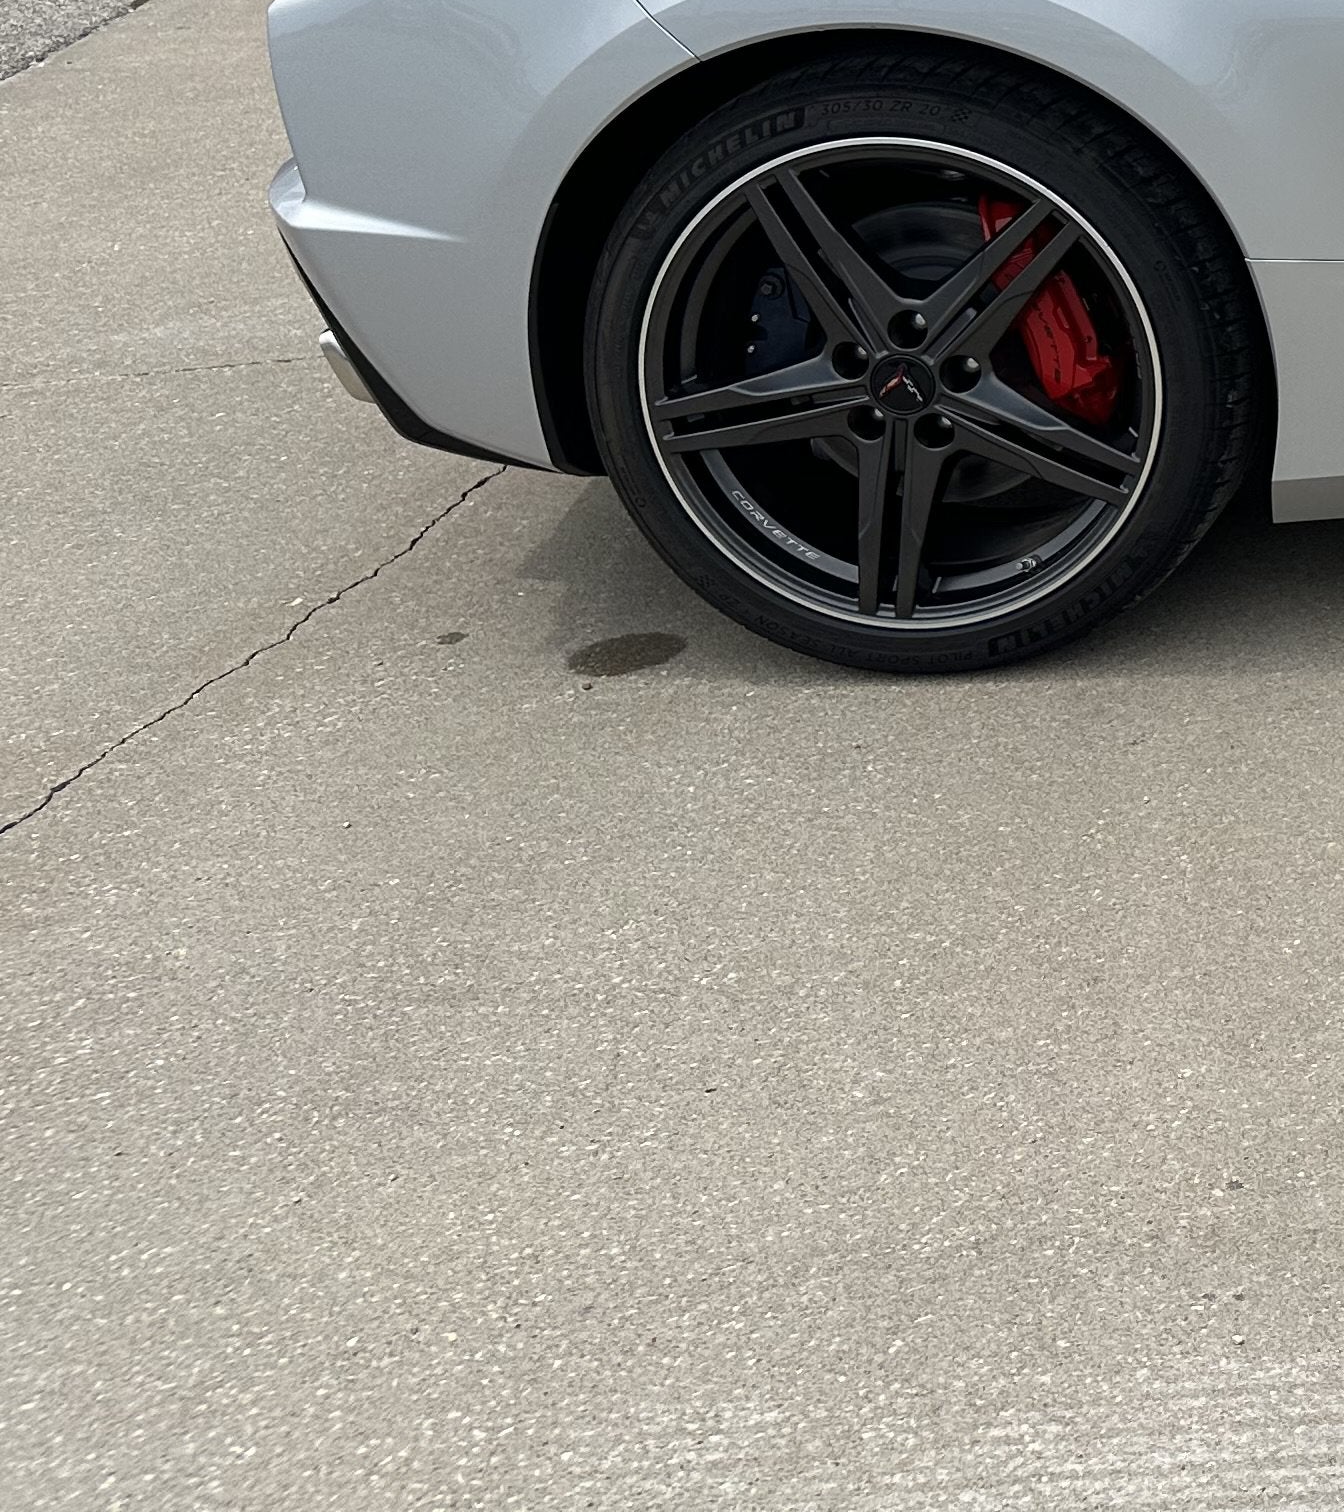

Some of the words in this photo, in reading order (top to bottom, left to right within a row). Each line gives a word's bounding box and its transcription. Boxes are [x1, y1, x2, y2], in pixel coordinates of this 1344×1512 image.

[821, 99, 884, 116] 305/30
[890, 100, 914, 113] ZR
[919, 103, 941, 117] 20
[659, 109, 798, 208] MICHELIN
[731, 490, 822, 561] CORVETTE
[864, 650, 921, 666] SPORT
[928, 650, 973, 665] PILOT
